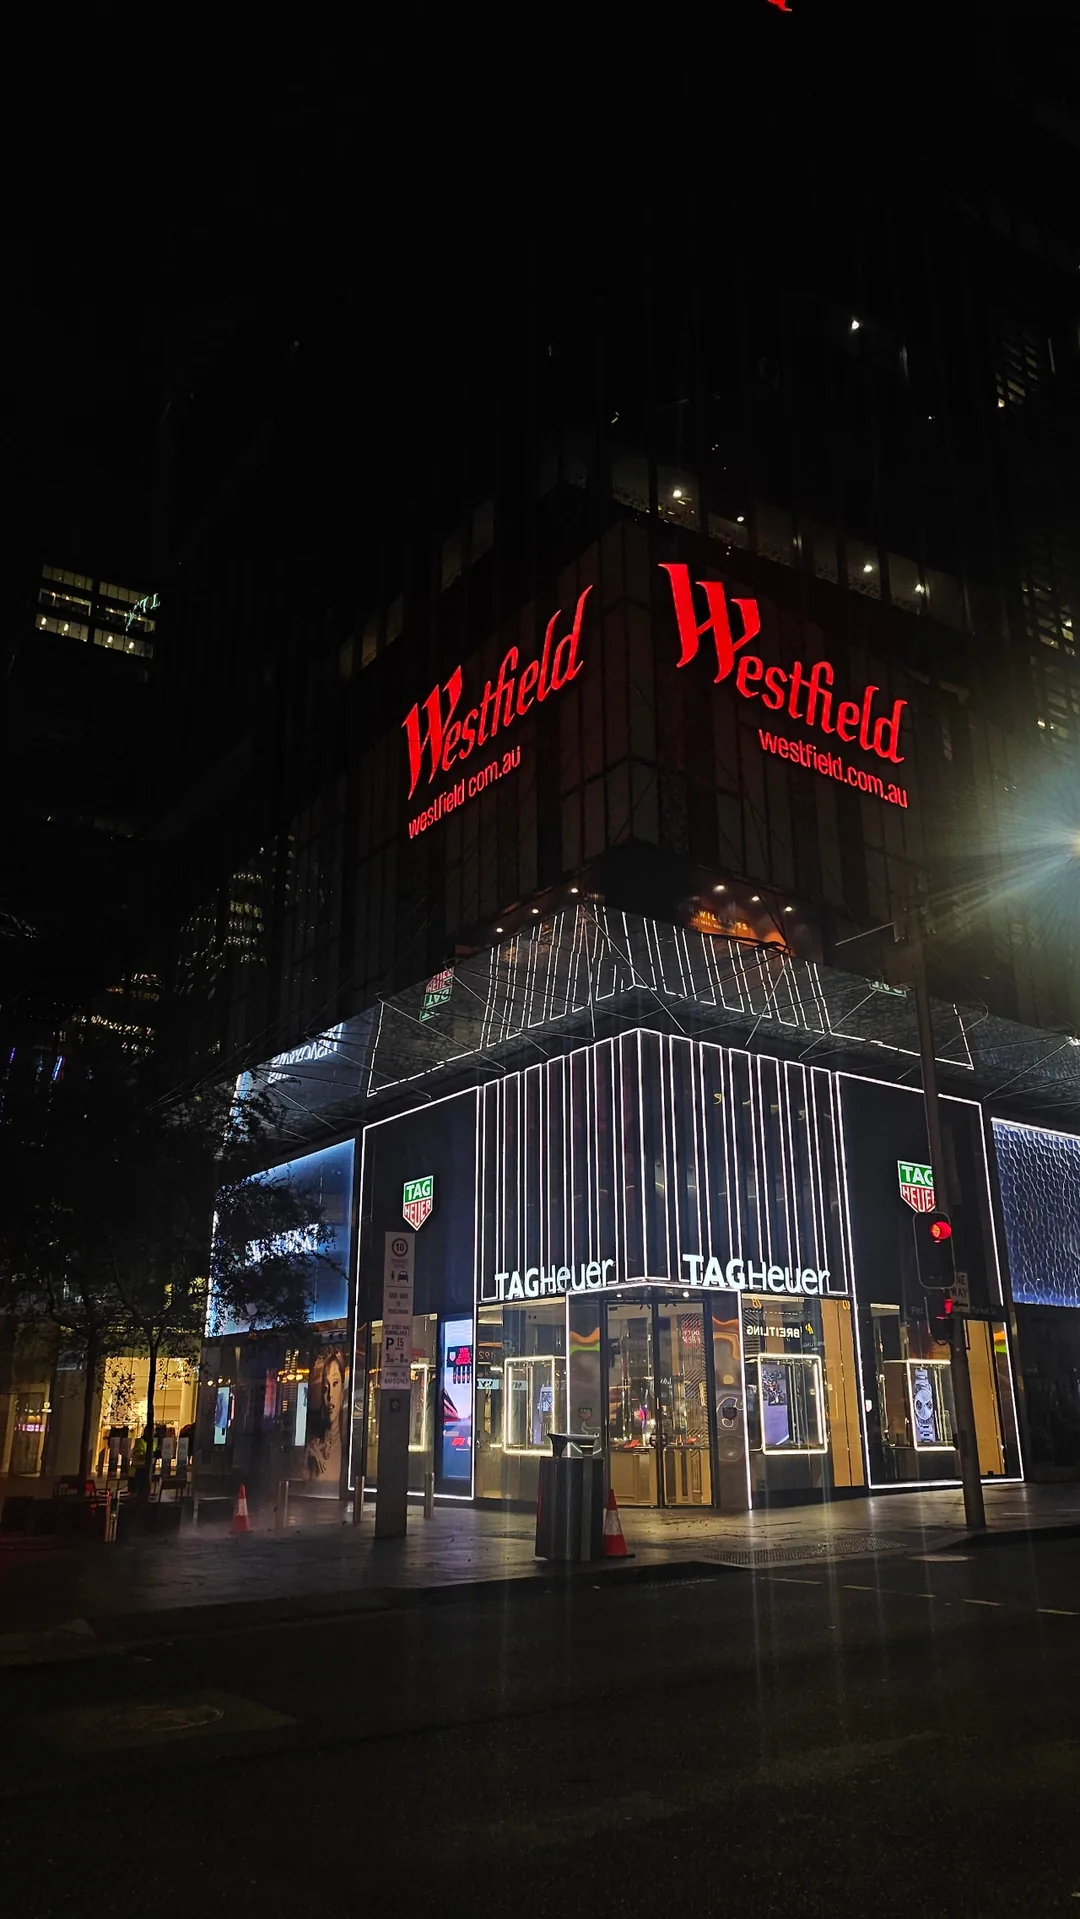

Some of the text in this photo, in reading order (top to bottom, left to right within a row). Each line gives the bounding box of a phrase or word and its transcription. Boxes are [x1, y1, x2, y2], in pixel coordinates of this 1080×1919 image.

[658, 563, 908, 763] Westfield
[401, 584, 593, 800] Westfield
[758, 729, 907, 808] westfield.com.au
[901, 1165, 934, 1187] TAG
[406, 1180, 431, 1201] TAG
[404, 1199, 431, 1227] HEUER
[396, 1242, 404, 1252] 10
[386, 1338, 395, 1350] P
